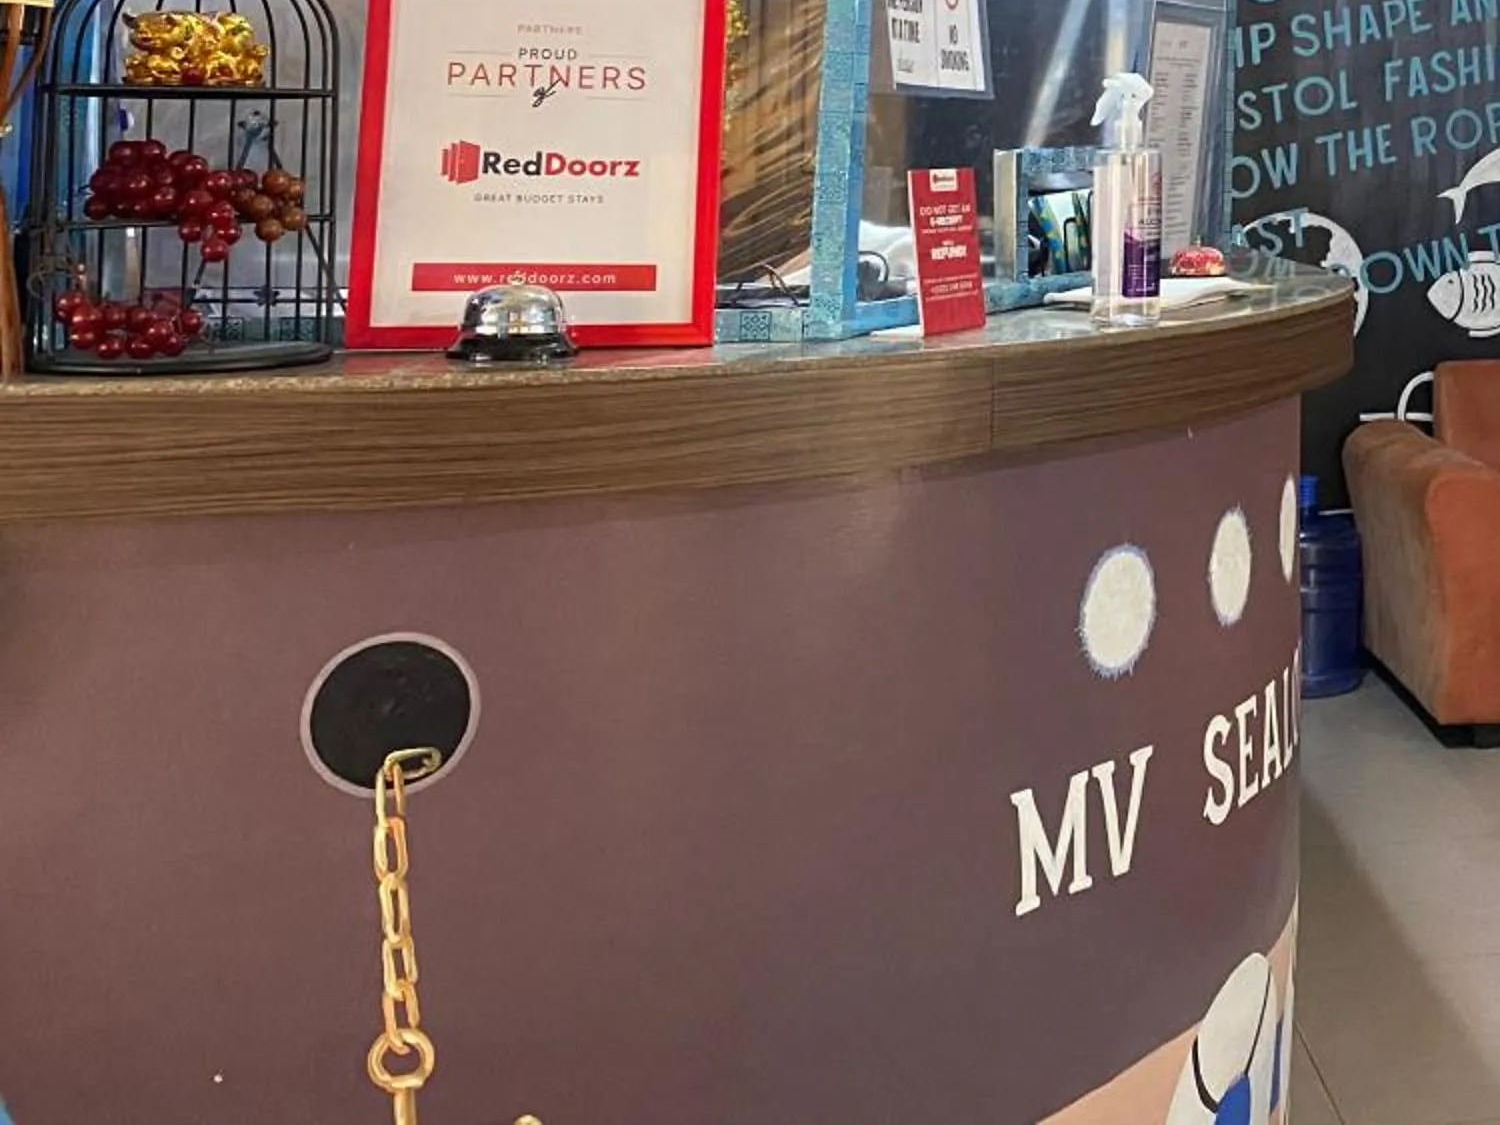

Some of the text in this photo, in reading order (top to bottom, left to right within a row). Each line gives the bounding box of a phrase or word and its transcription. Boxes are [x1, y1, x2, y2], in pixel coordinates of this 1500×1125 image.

[949, 24, 959, 46] NO
[518, 47, 578, 61] PROUD
[940, 49, 971, 72] SMOKING
[447, 62, 647, 91] PARTNERS
[532, 78, 562, 108] of
[1237, 69, 1358, 131] STOL
[1315, 122, 1397, 176] THE
[482, 151, 641, 177] RedDoorz
[474, 193, 604, 204] GREAT BUDGET STAYS
[1010, 643, 1300, 917] MV SEAL
